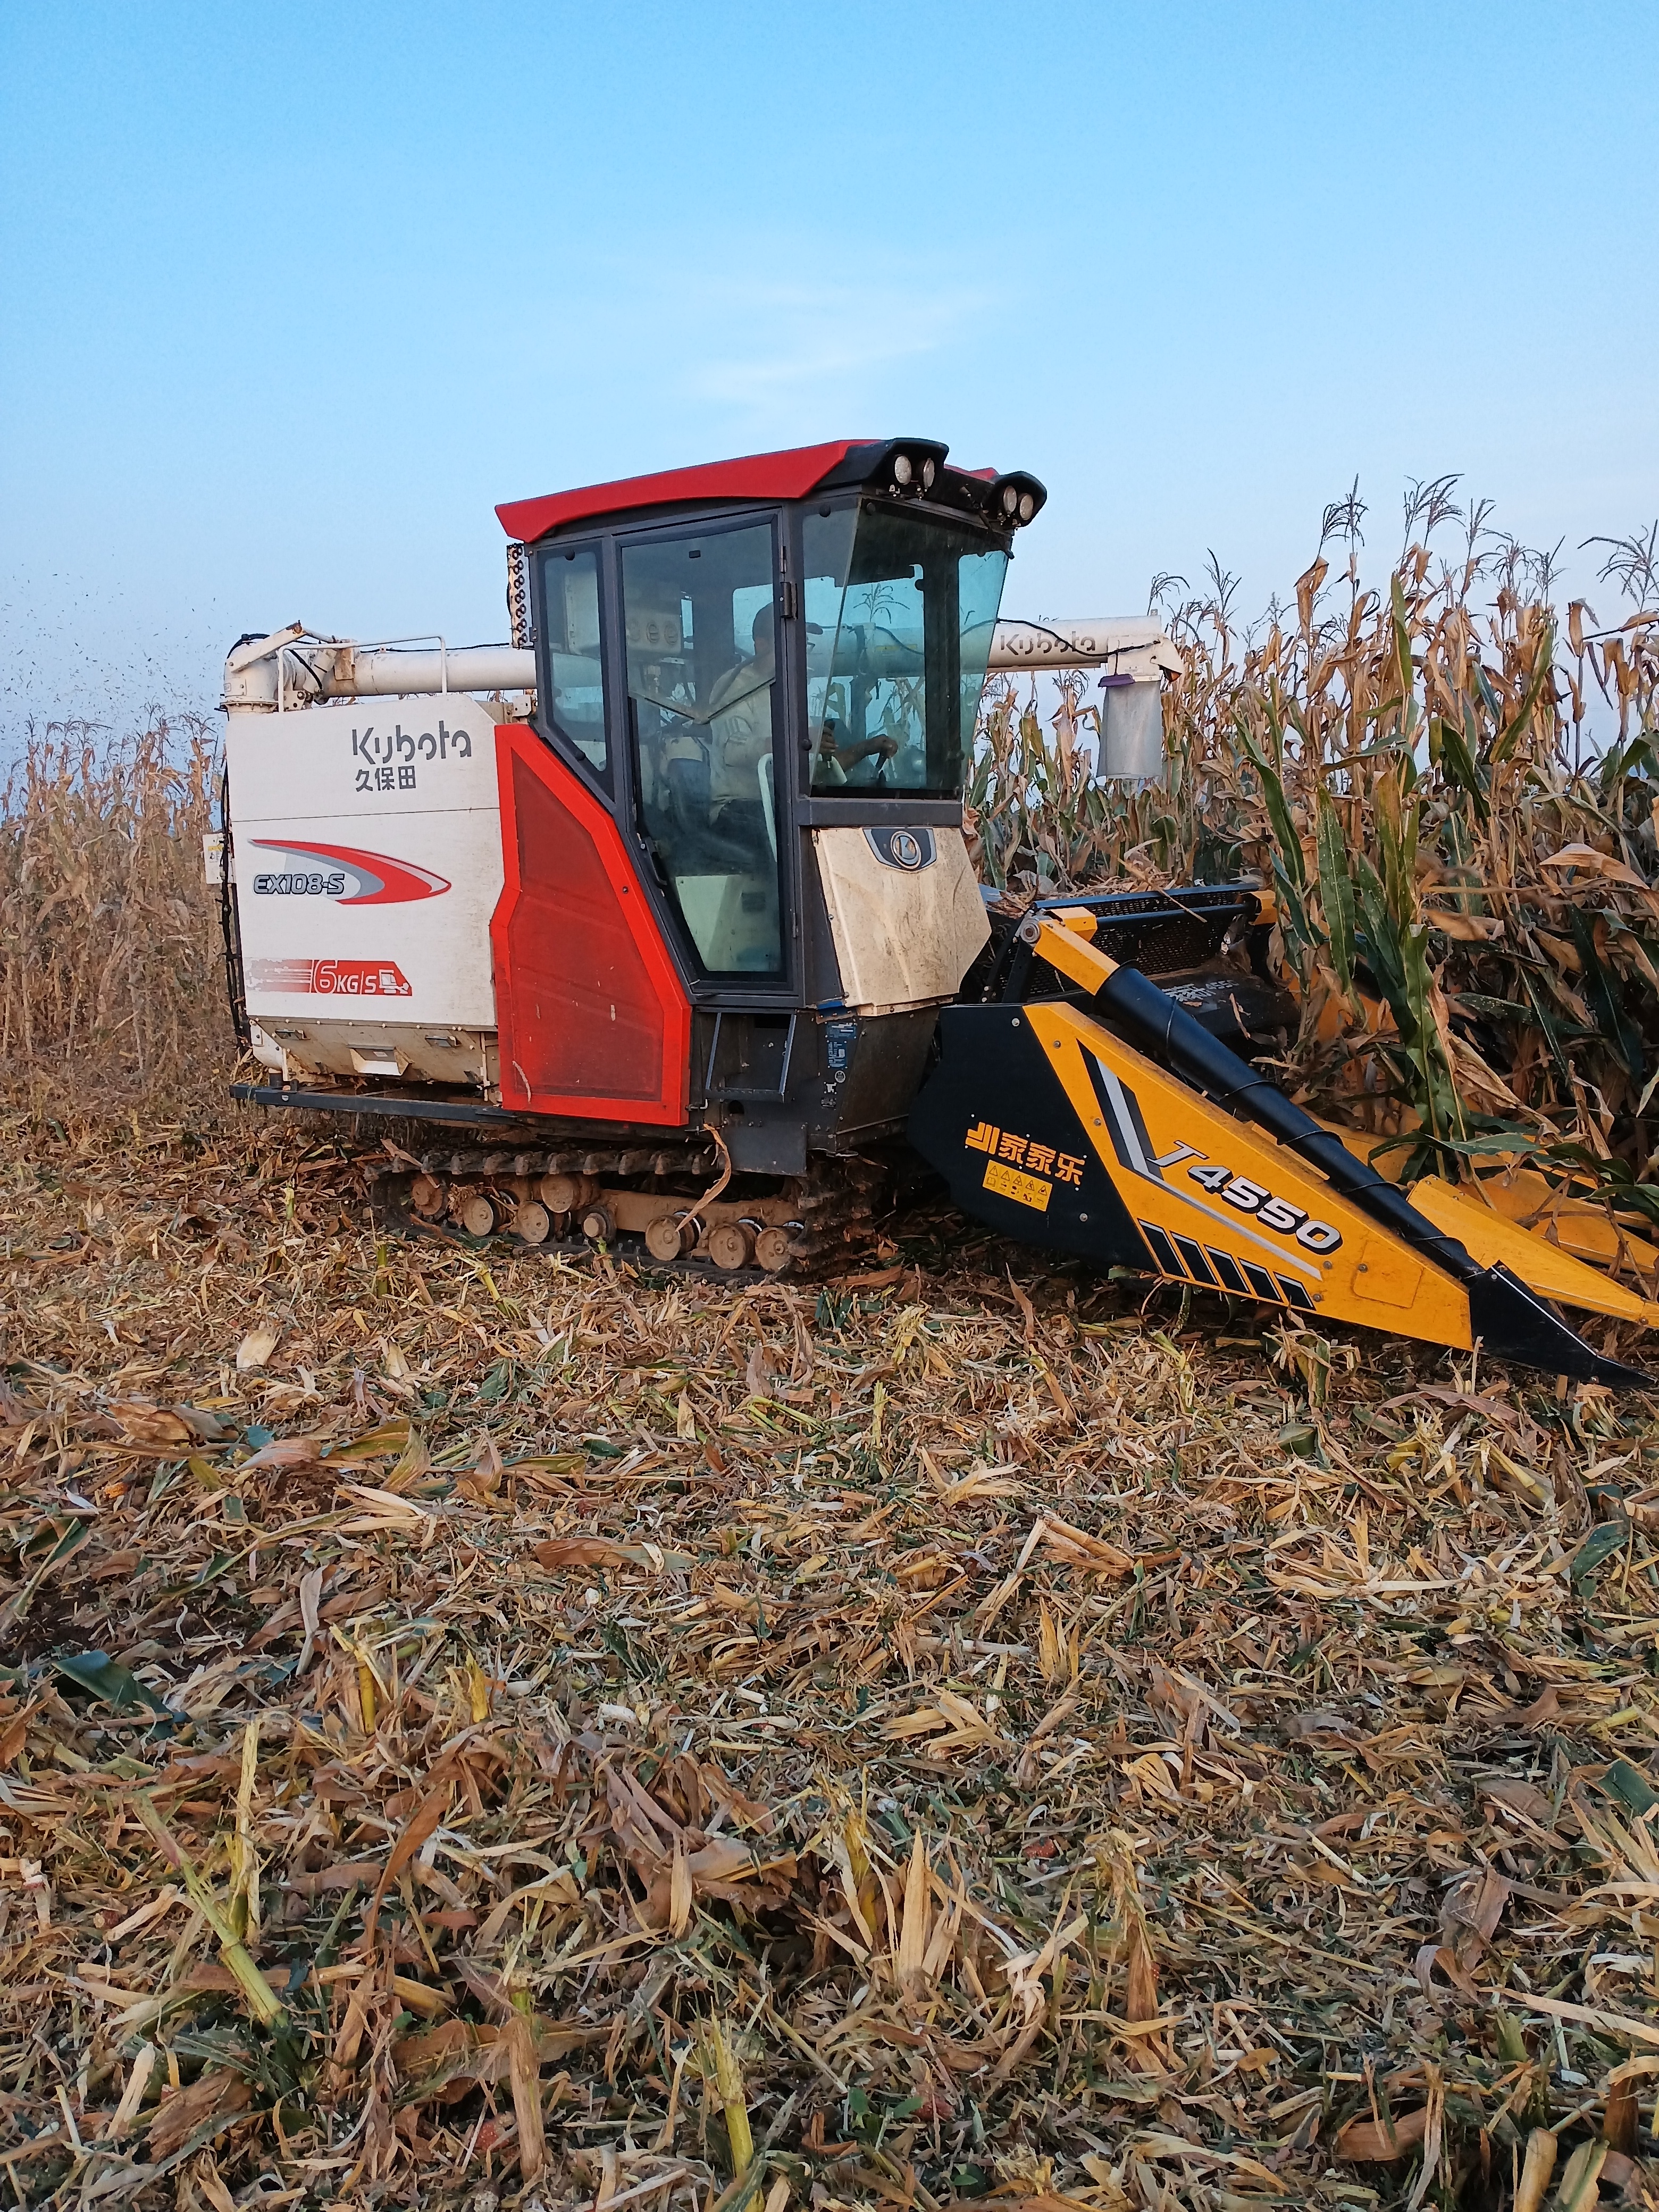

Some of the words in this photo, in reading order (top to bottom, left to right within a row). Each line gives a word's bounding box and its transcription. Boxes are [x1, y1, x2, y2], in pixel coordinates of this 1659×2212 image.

[1000, 631, 1095, 655] Kubota
[352, 720, 472, 765] Kubota
[355, 765, 416, 792] 久保田
[254, 873, 345, 894] EX108-S
